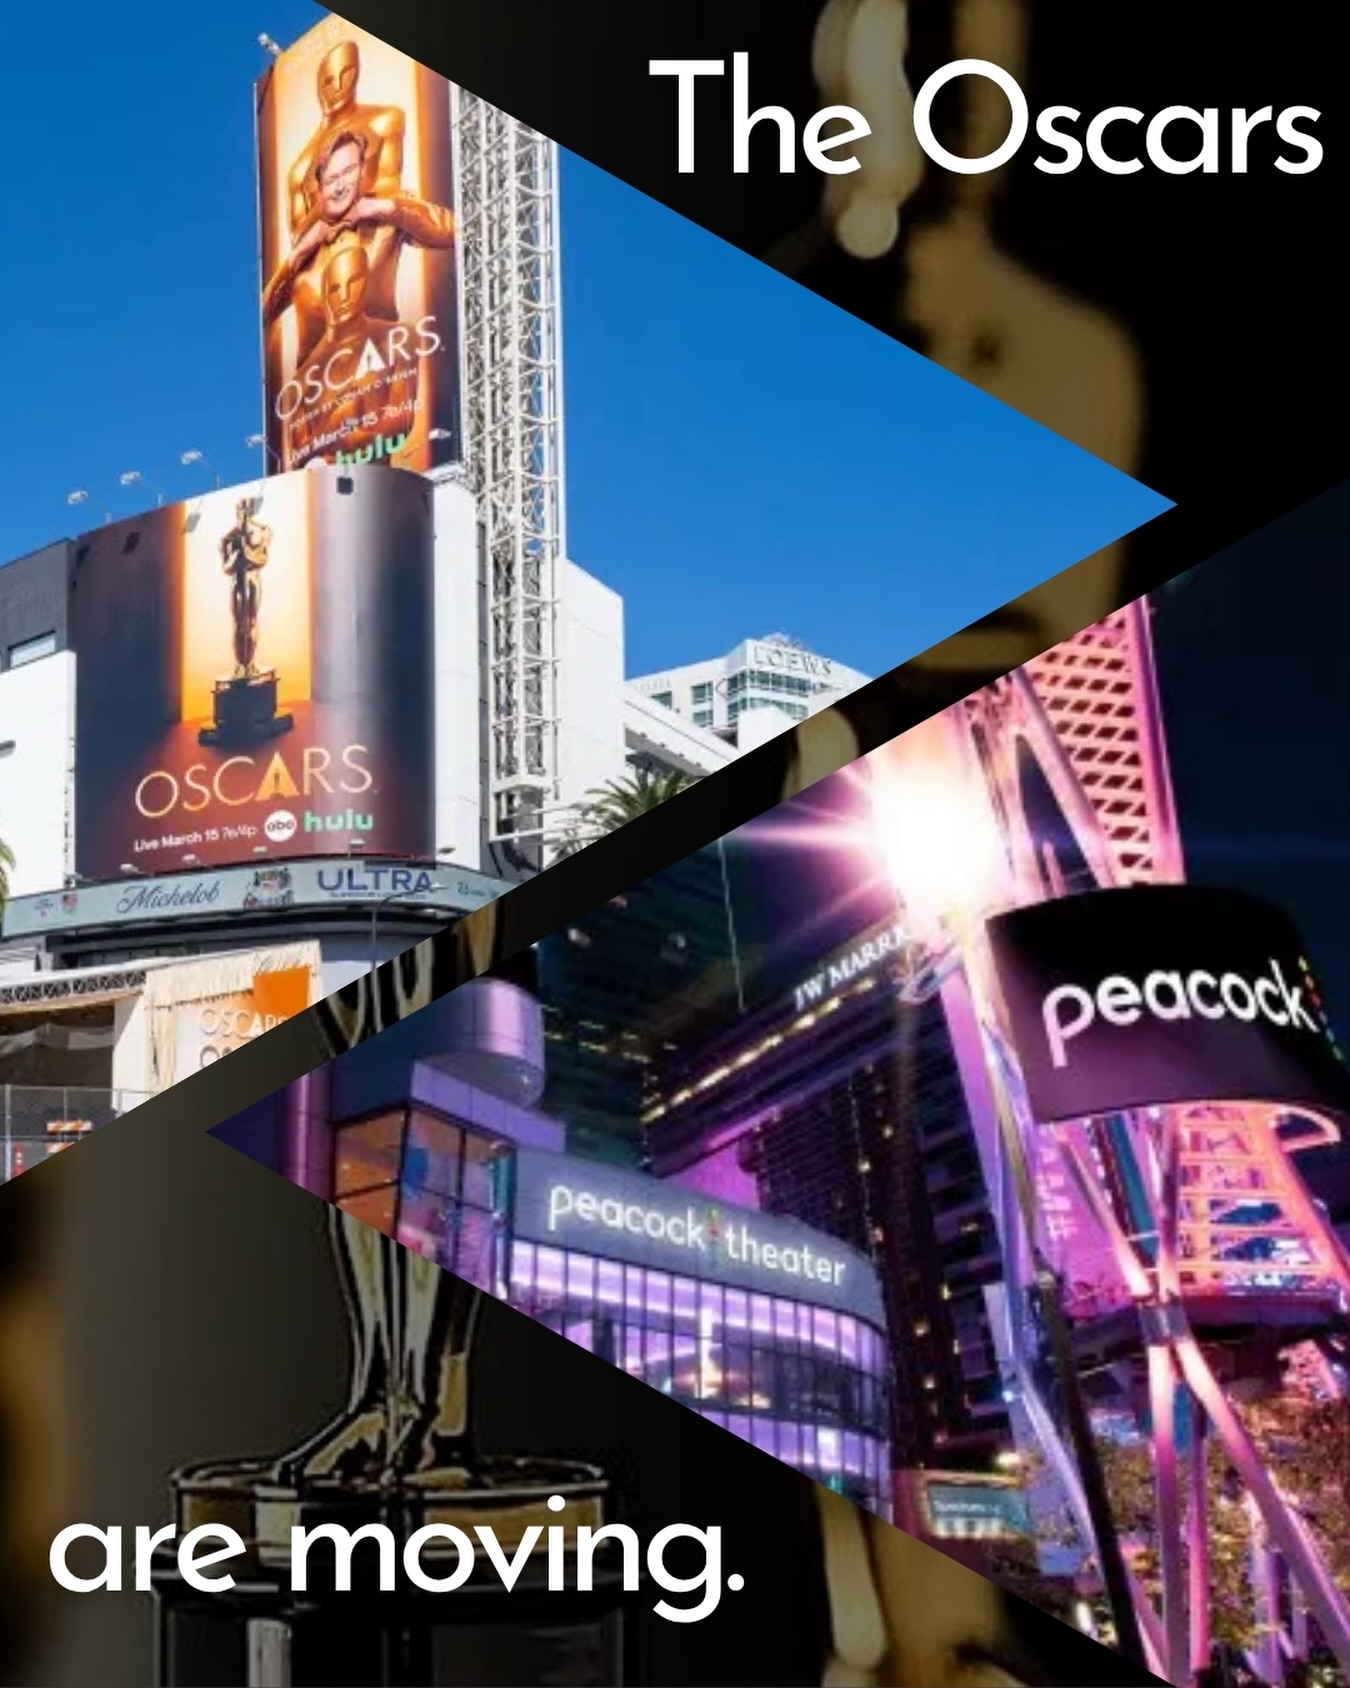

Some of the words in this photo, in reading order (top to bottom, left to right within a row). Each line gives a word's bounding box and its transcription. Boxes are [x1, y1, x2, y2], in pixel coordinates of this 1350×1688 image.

[274, 315, 442, 420] OSCARS
[335, 432, 407, 466] hulu
[754, 645, 832, 676] LOEWS
[135, 744, 374, 819] OSCARS
[134, 839, 159, 853] Live
[161, 832, 202, 849] March
[204, 829, 219, 841] 15
[266, 818, 295, 833] abc
[303, 809, 374, 834] hulu
[116, 879, 222, 918] Michelob
[317, 867, 434, 894] ULTRA
[1042, 958, 1321, 1069] peacock
[547, 1184, 707, 1251] peacock
[724, 1225, 847, 1286] theater
